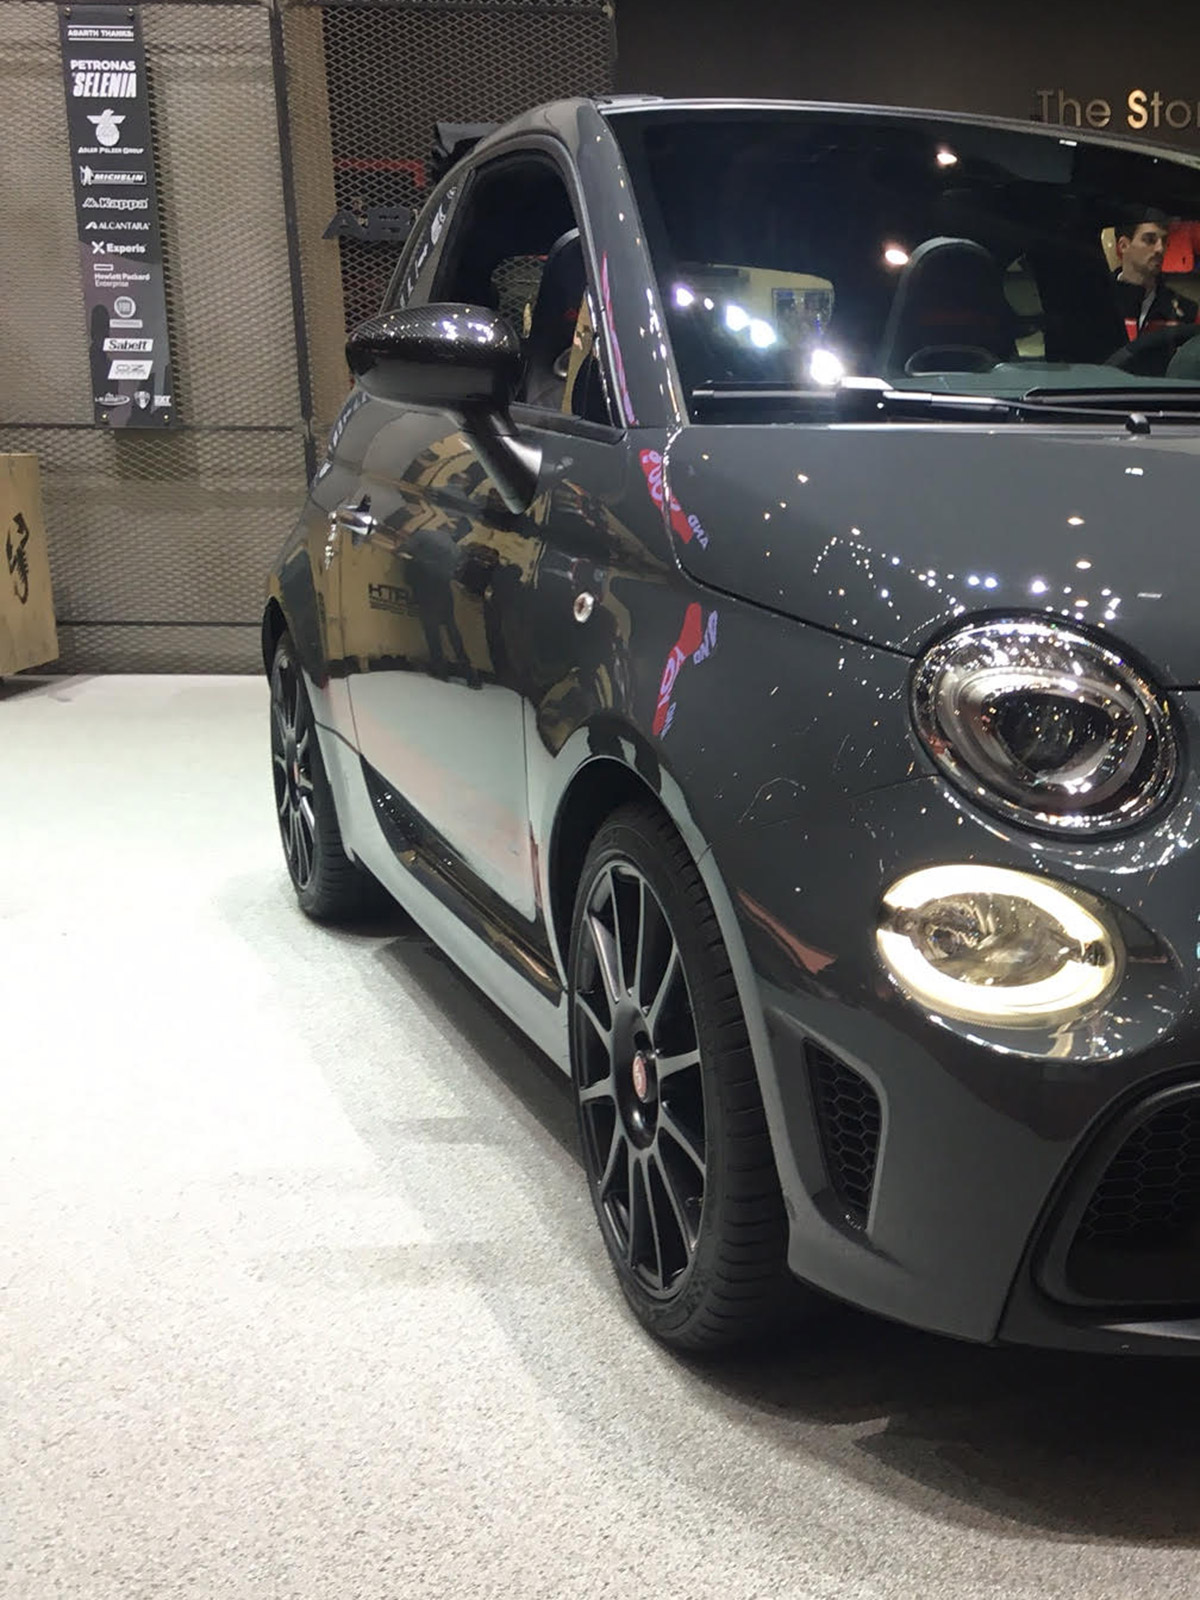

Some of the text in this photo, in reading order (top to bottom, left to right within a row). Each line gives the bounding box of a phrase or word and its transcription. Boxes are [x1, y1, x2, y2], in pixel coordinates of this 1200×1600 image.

[67, 29, 99, 37] ABARTH
[70, 60, 136, 71] PETRONAS
[73, 72, 137, 98] SELENIA
[1037, 89, 1111, 127] The
[99, 197, 148, 210] Kappa
[99, 222, 149, 230] ALCANTARA
[106, 243, 146, 254] Experis
[109, 340, 147, 350] Sabelt
